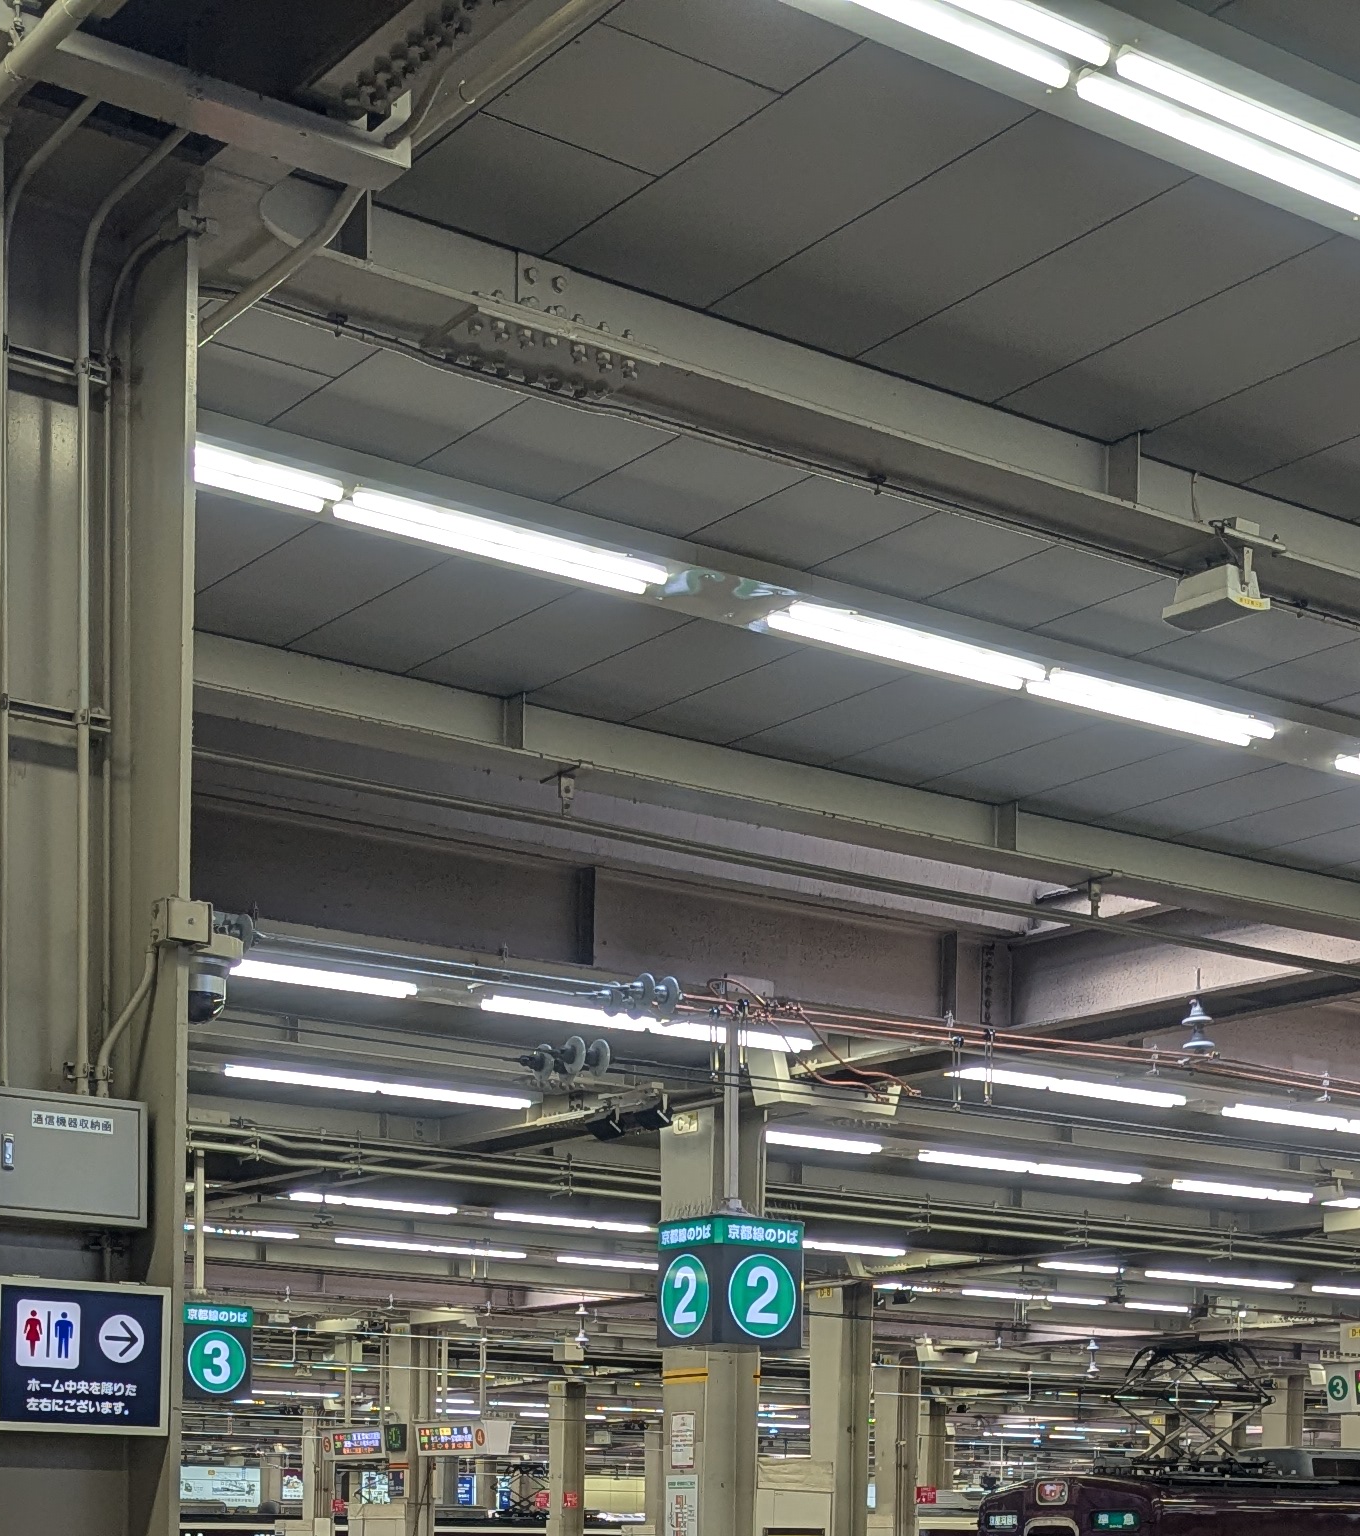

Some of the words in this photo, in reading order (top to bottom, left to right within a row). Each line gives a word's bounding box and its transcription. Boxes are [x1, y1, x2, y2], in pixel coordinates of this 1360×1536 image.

[32, 1112, 113, 1133] 通信機器収納函
[660, 1223, 712, 1246] 京都線のりば
[727, 1223, 800, 1245] 京都線のりば
[673, 1265, 697, 1325] 2
[745, 1265, 779, 1325] 2
[187, 1307, 248, 1324] 京都線のりば
[202, 1339, 231, 1385] 3
[26, 1377, 137, 1397] ホーム中央を降りた
[1331, 1378, 1344, 1398] 3
[25, 1396, 130, 1416] 左右にございます。
